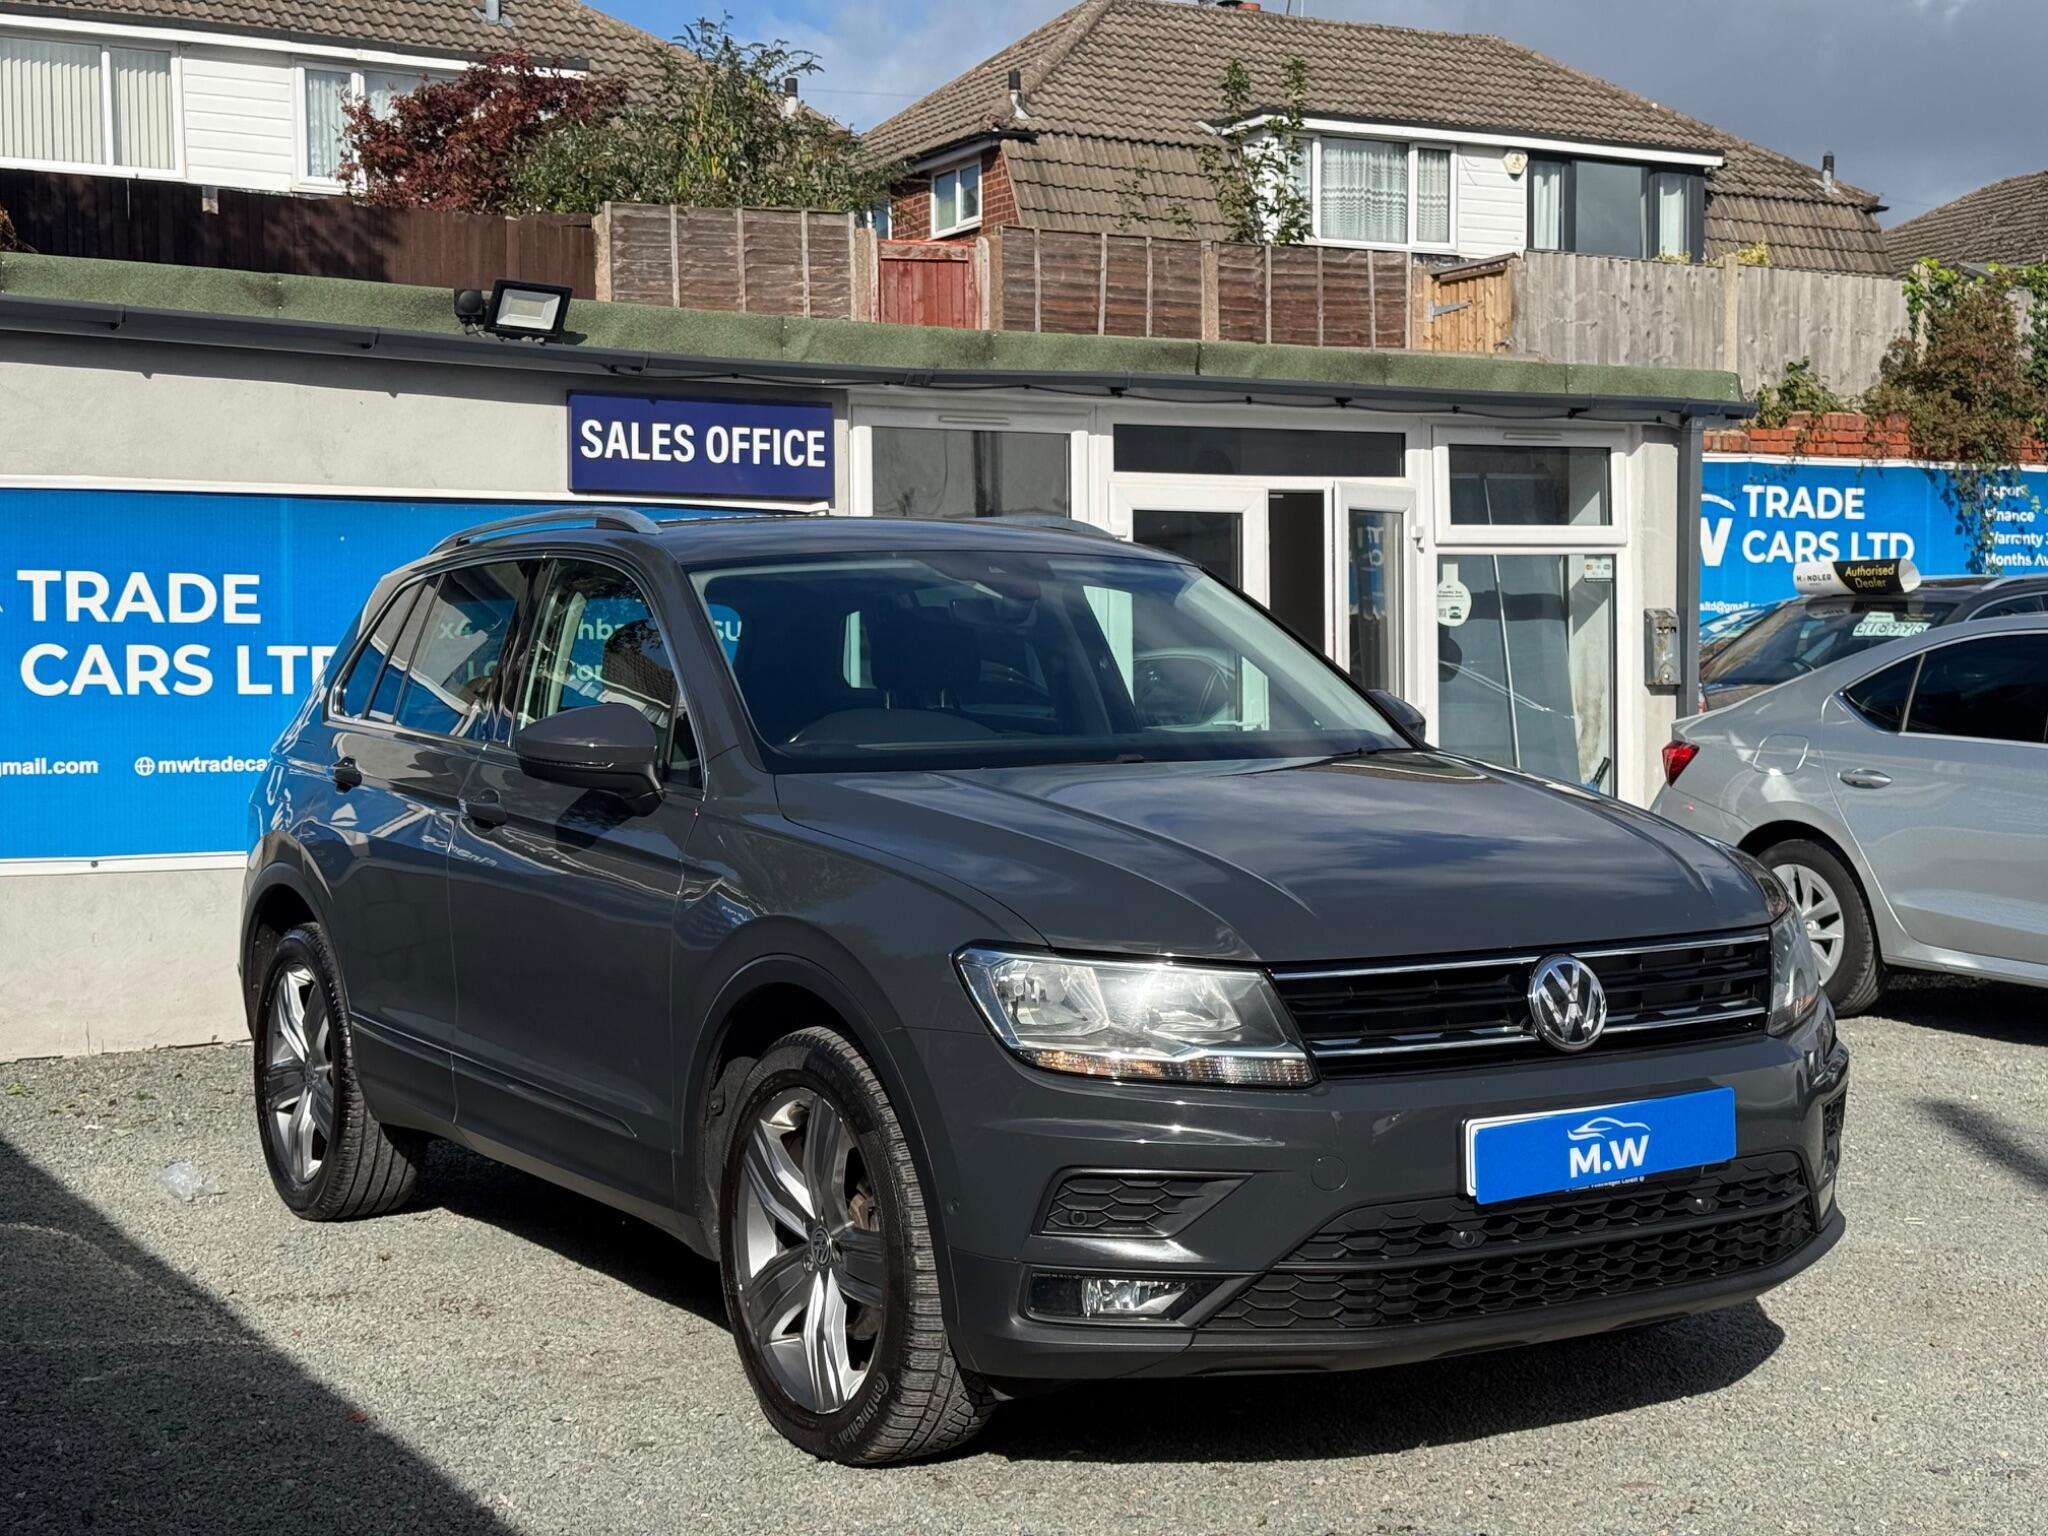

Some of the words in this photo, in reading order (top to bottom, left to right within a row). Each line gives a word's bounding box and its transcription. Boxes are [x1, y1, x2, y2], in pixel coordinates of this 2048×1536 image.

[580, 419, 696, 463] SALES
[704, 425, 827, 468] OFFICE
[1742, 485, 1866, 520] TRADE
[1741, 529, 1840, 563] CARS
[1850, 532, 1915, 562] LTD
[1845, 564, 1895, 577] Authorised
[16, 569, 262, 625] TRADE
[20, 643, 214, 697] CARS
[0, 757, 99, 777] mail.com
[158, 756, 272, 774] mwtradeca
[1568, 1134, 1650, 1179] M.W
